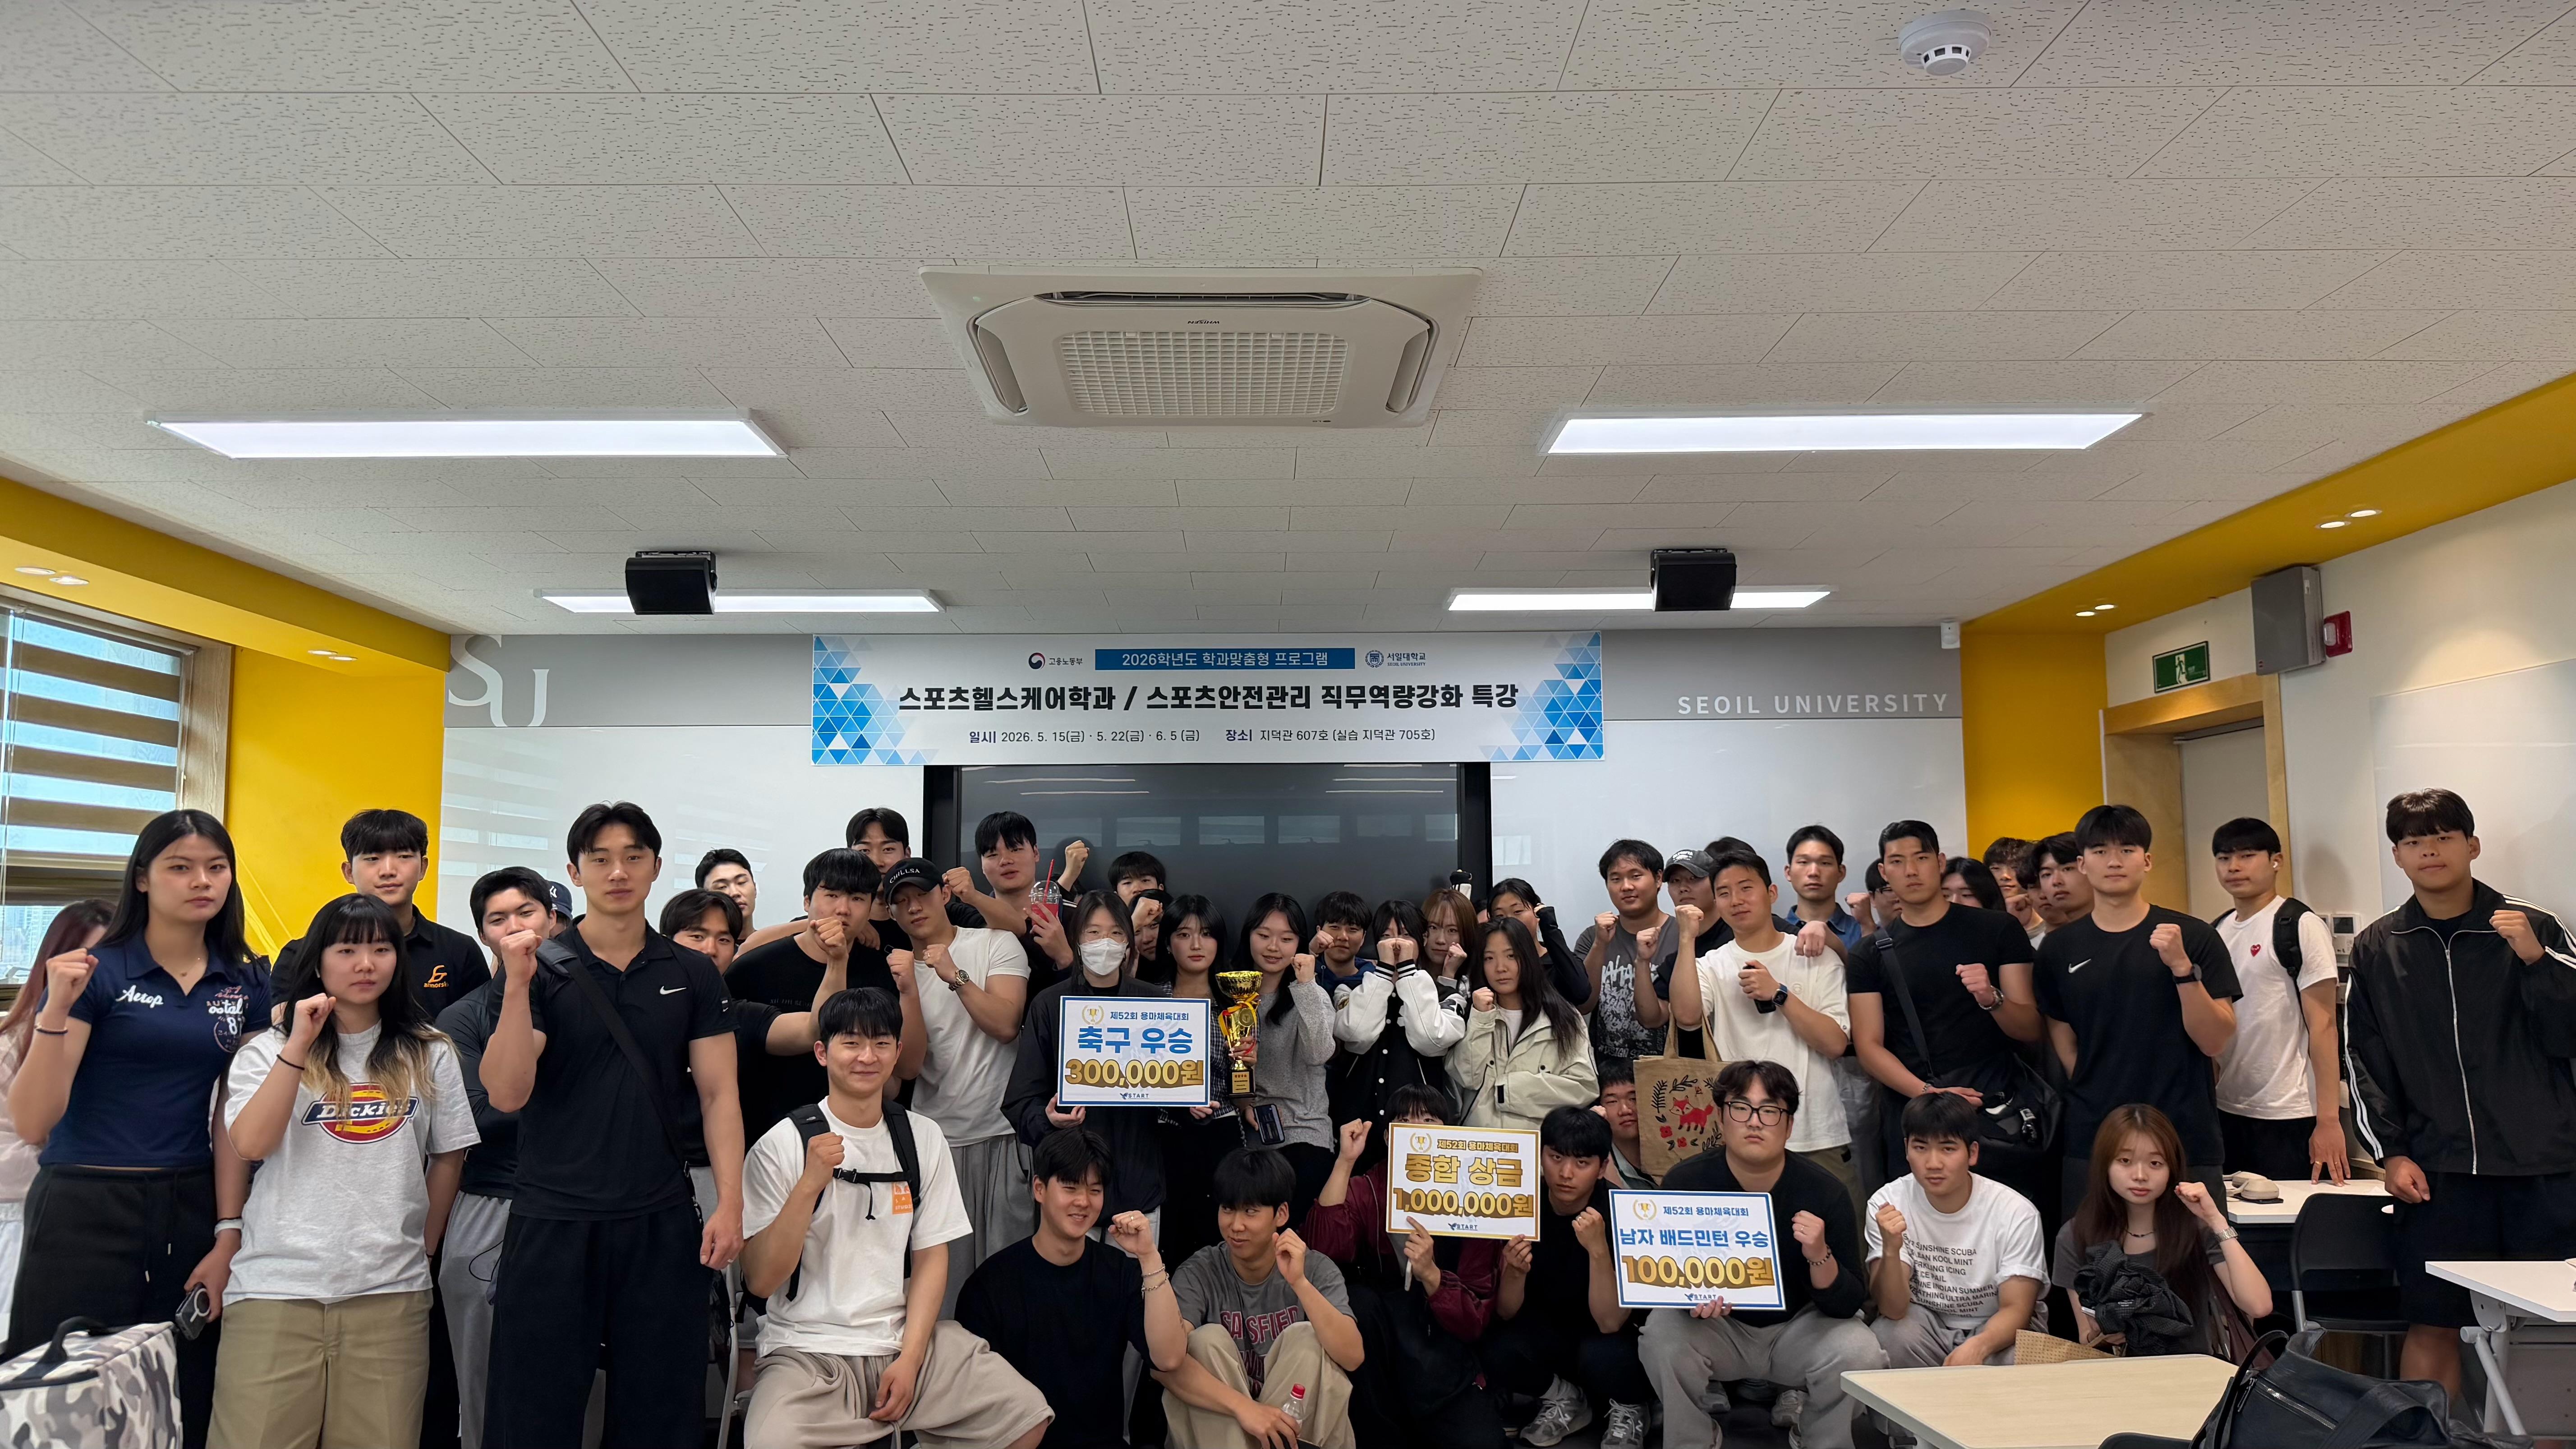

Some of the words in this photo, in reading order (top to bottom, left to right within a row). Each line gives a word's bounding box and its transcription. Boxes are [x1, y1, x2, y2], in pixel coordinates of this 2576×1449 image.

[1049, 657, 1083, 666] 고용노동부
[1122, 653, 1197, 667] 2026학년도
[1202, 653, 1270, 667] 학과맞춤형
[1275, 652, 1328, 666] 프로그램
[1387, 653, 1426, 661] 서일대학교
[899, 686, 1116, 711] 스포츠헬스케어학과
[1123, 686, 1138, 711] /
[1146, 685, 1311, 710] 스포츠안전관리
[1321, 684, 1464, 709] 직무역량강화
[1471, 684, 1519, 708] 특강
[1678, 696, 1760, 714] SEOIL
[1774, 694, 1947, 713] UNIVERSITY
[1001, 731, 1034, 743] 2026.
[1037, 731, 1048, 742] 5.
[1053, 731, 1085, 744] 15(금)
[1097, 731, 1107, 742] 5.
[1111, 731, 1145, 743] 22(금)
[1156, 731, 1167, 741] 6.
[1171, 731, 1177, 741] 5
[1181, 730, 1200, 742] (금)
[1260, 729, 1293, 742] 지덕관
[1297, 729, 1329, 741] 607호
[1333, 729, 1358, 741] (실습
[1362, 729, 1395, 741] 지덕관
[1399, 729, 1435, 741] 705호)
[1110, 1011, 1137, 1020] 제52회
[1140, 1012, 1189, 1021] 용마체육대회
[1078, 1026, 1131, 1053] 축구
[1141, 1028, 1193, 1054] 우승
[1065, 1058, 1204, 1089] 300,000원
[1437, 1139, 1466, 1150] 제52회
[1468, 1141, 1519, 1153] 용마체육대회
[1405, 1153, 1461, 1184] 종합
[1468, 1157, 1523, 1187] 상금
[1393, 1187, 1534, 1218] 1,000,000원
[1663, 1206, 1693, 1215] 제52회
[1696, 1207, 1748, 1216] 용마체육대회
[1619, 1228, 1654, 1246] 남자
[1660, 1229, 1729, 1247] 배드민턴
[1735, 1230, 1768, 1248] 우승
[1932, 1255, 1952, 1265] KOOL
[1954, 1258, 1973, 1266] MINT
[1621, 1255, 1775, 1289] 100,000원
[1946, 1266, 1966, 1275] ICING
[1959, 1284, 1993, 1294] SUMMER
[1946, 1293, 1971, 1302] ULTRA
[1956, 1300, 1984, 1308] SCUBA
